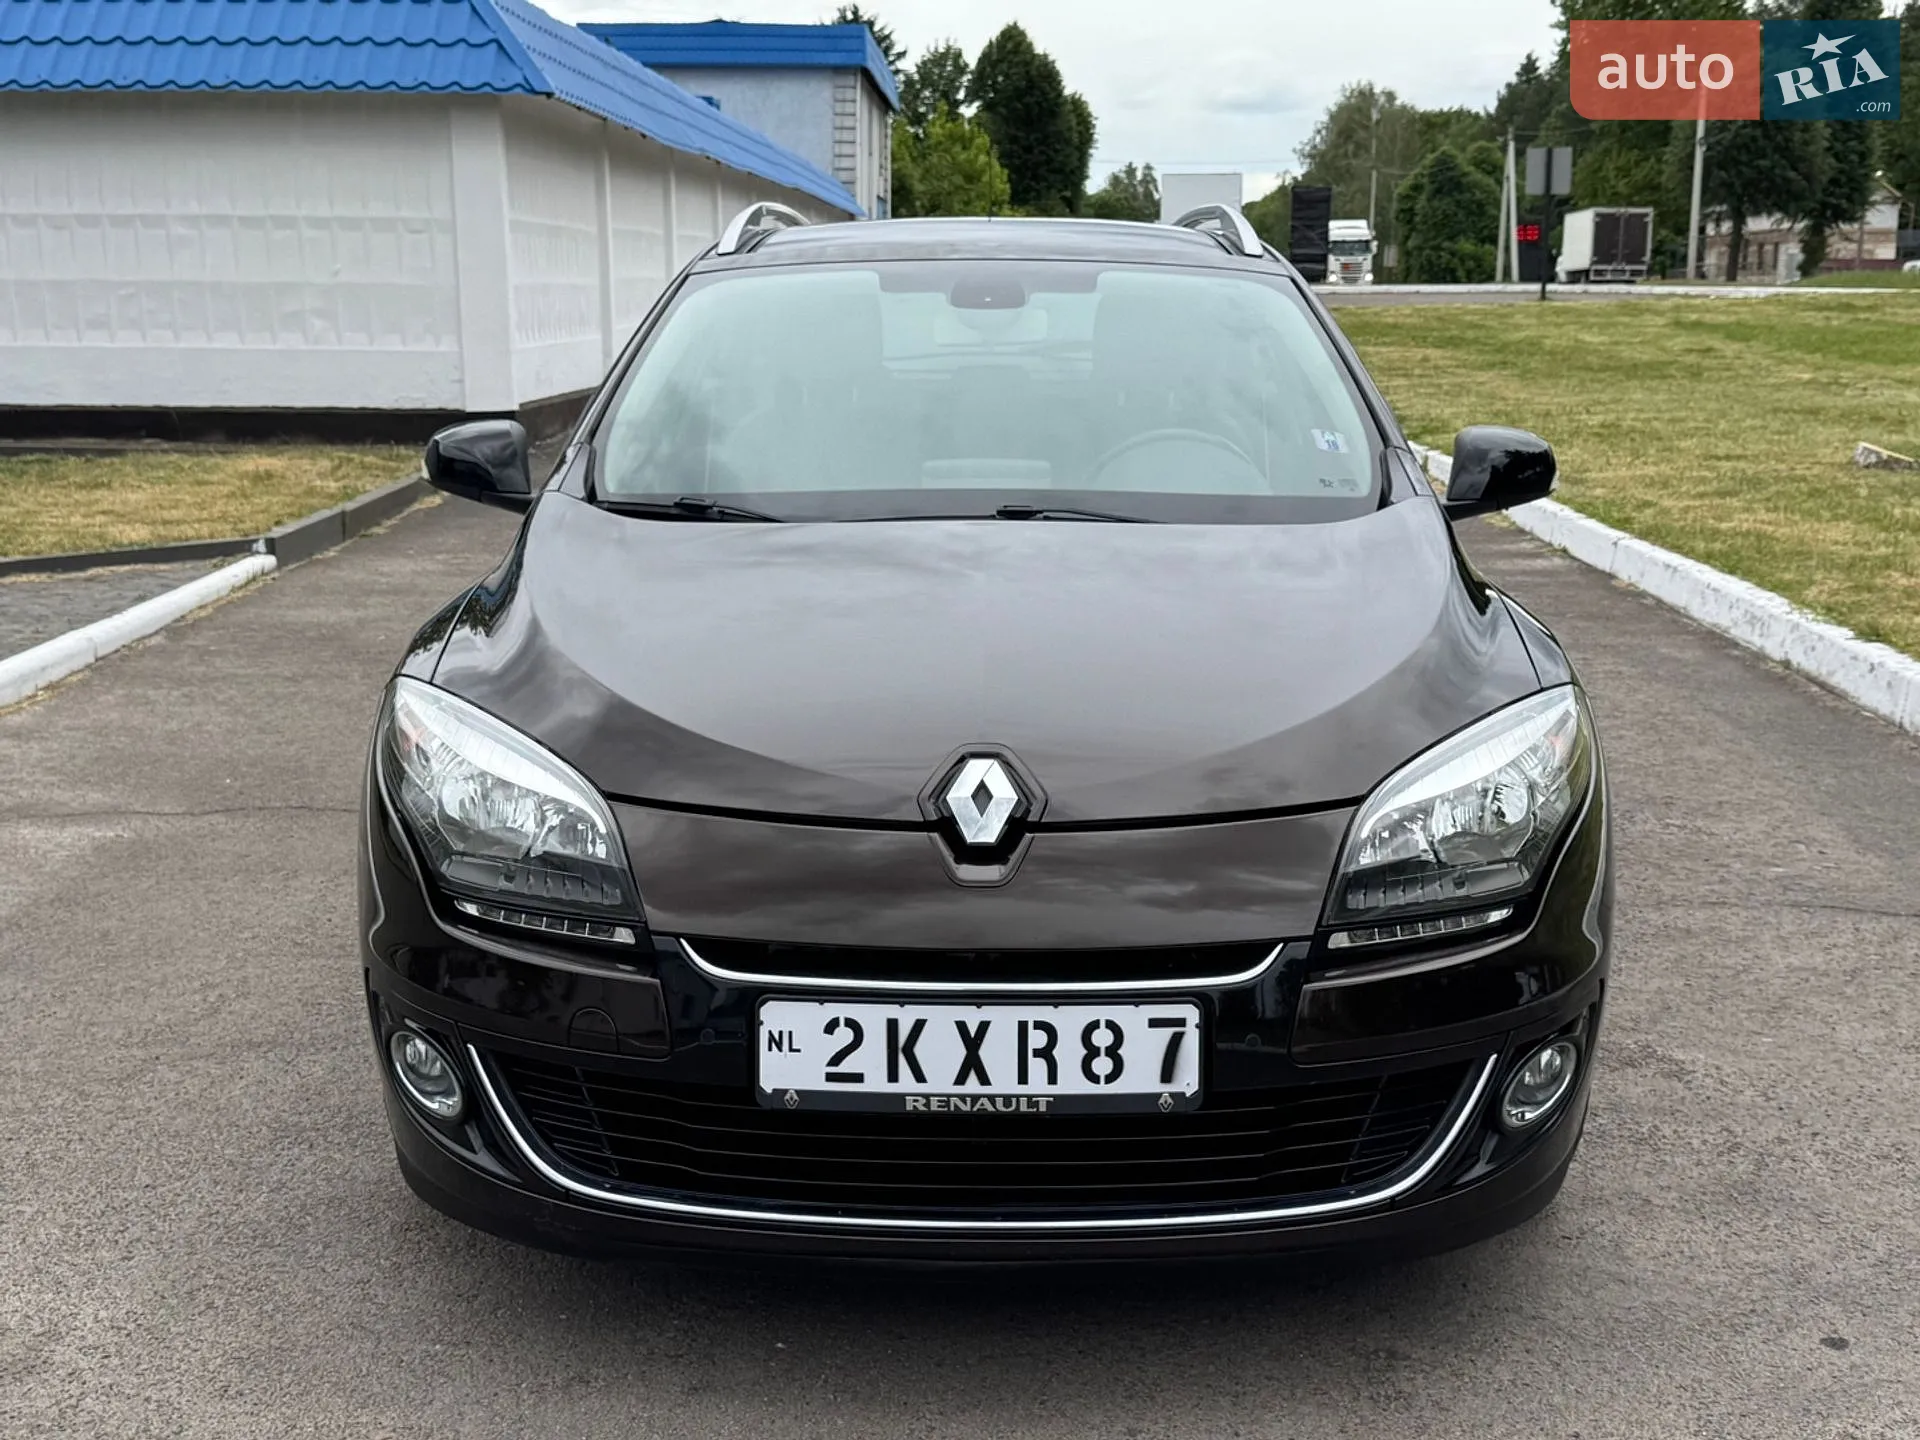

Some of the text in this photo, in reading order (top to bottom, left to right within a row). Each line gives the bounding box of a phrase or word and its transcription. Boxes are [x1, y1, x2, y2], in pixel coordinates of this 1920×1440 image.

[767, 1016, 1187, 1087] NL 2KXR87
[905, 1095, 1054, 1112] RENAULT
